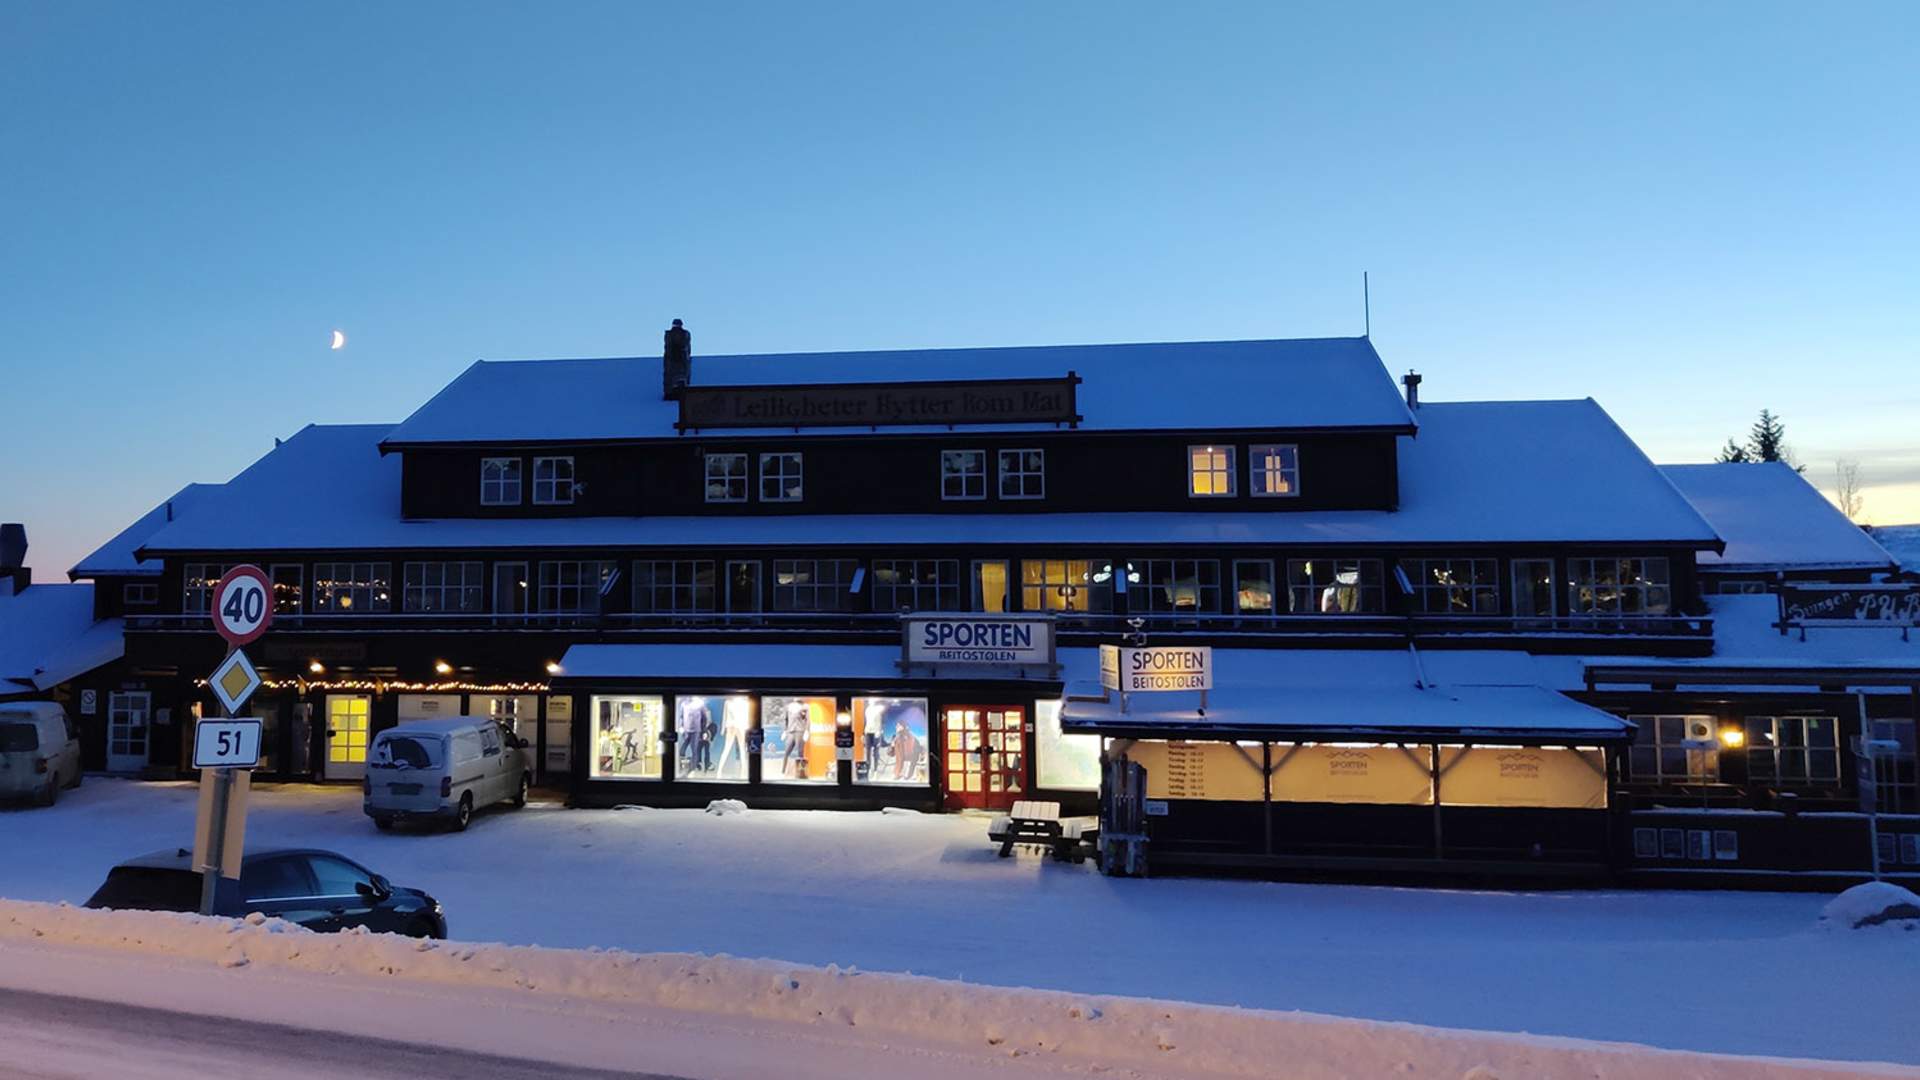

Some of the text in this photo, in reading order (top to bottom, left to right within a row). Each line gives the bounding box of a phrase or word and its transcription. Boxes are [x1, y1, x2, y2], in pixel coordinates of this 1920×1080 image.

[735, 394, 868, 418] Leiligheter
[962, 390, 1014, 413] Rom
[1022, 389, 1066, 411] Mat
[223, 587, 264, 624] 40
[924, 622, 1032, 648] SPORTEN
[939, 650, 1017, 662] BEITOSTØLEN
[1132, 651, 1204, 671] SPORTEN
[1133, 675, 1205, 689] BEITOSTØLEN
[217, 731, 242, 756] 51
[1329, 760, 1368, 769] SPORTEN
